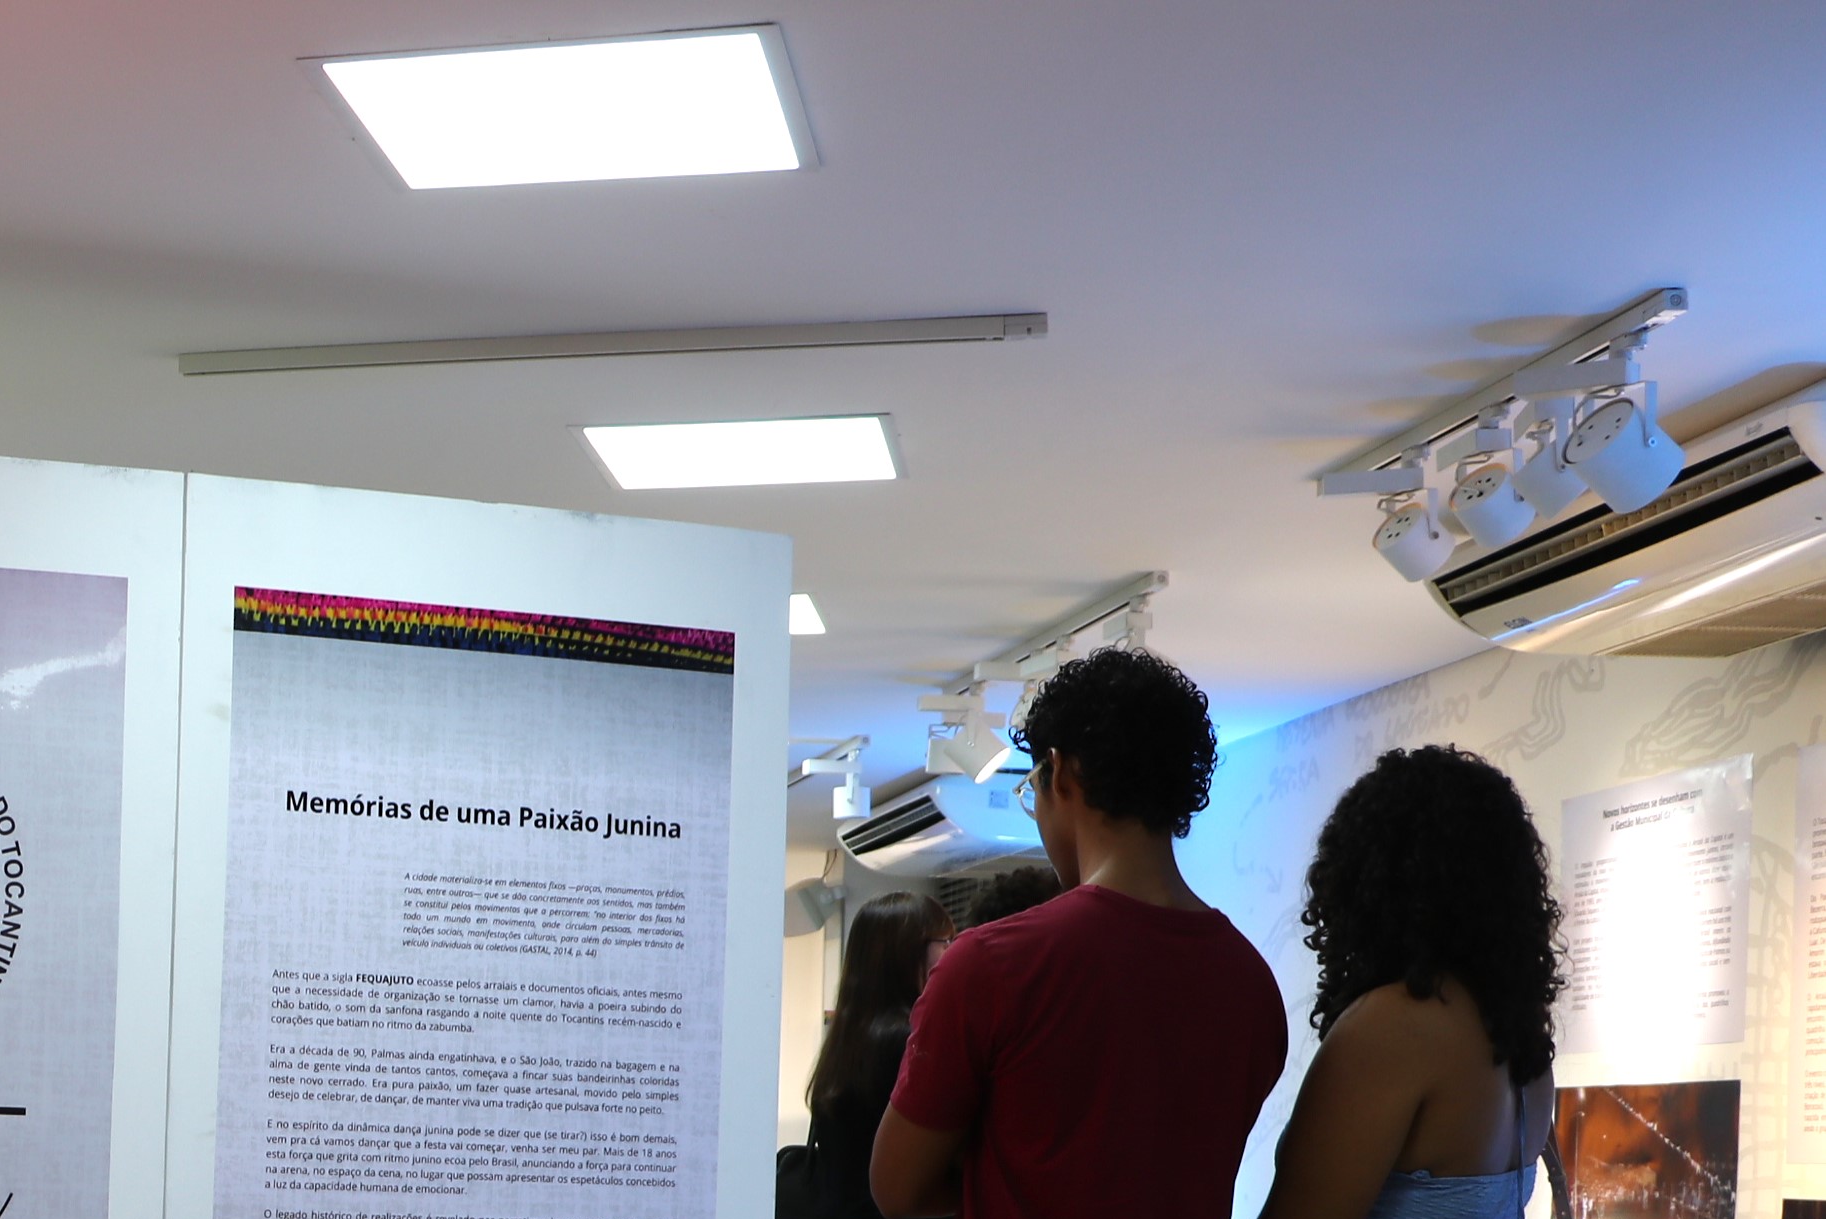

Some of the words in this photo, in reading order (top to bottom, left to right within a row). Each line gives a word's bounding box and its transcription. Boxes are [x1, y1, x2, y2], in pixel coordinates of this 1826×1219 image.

[286, 789, 412, 820] Memórias
[419, 799, 449, 822] de
[457, 806, 511, 827] uma
[519, 806, 599, 833] Paixão
[602, 813, 681, 840] Junina
[1620, 801, 1650, 815] horizontes
[1658, 792, 1689, 806] desenham
[271, 985, 291, 996] que
[294, 986, 301, 995] a
[305, 987, 364, 999] necessidade
[367, 988, 380, 999] de
[383, 990, 441, 1004] organização
[444, 994, 455, 1003] se
[459, 994, 499, 1006] tornasse
[503, 997, 519, 1006] um
[522, 996, 556, 1009] clamor,
[560, 998, 585, 1010] havia
[588, 1002, 594, 1011] a
[597, 1002, 627, 1013] poeira
[630, 1002, 667, 1014] subindo
[670, 1004, 682, 1015] do
[272, 968, 300, 980] Antes
[302, 972, 321, 983] que
[323, 973, 329, 981] a
[332, 972, 353, 985] sigla
[355, 972, 414, 987] FEQUAJUTO
[416, 978, 454, 988] ecoasse
[456, 978, 481, 991] pelos
[483, 981, 518, 991] arraiais
[520, 983, 526, 992] e
[528, 982, 585, 995] documentos
[587, 985, 620, 998] oficiais,
[622, 989, 647, 999] antes
[649, 991, 683, 1000] mesmo
[271, 998, 295, 1010] chão
[298, 999, 331, 1013] batido,
[334, 1004, 342, 1012] o
[345, 1004, 366, 1014] som
[369, 1003, 382, 1014] da
[385, 1004, 423, 1016] sanfona
[426, 1008, 470, 1020] rasgando
[473, 1010, 480, 1019] a
[482, 1010, 507, 1021] noite
[509, 1012, 543, 1023] quente
[545, 1012, 558, 1023] do
[561, 1013, 605, 1026] Tocantins
[607, 1016, 673, 1029] recém-nascido
[676, 1021, 682, 1030] e
